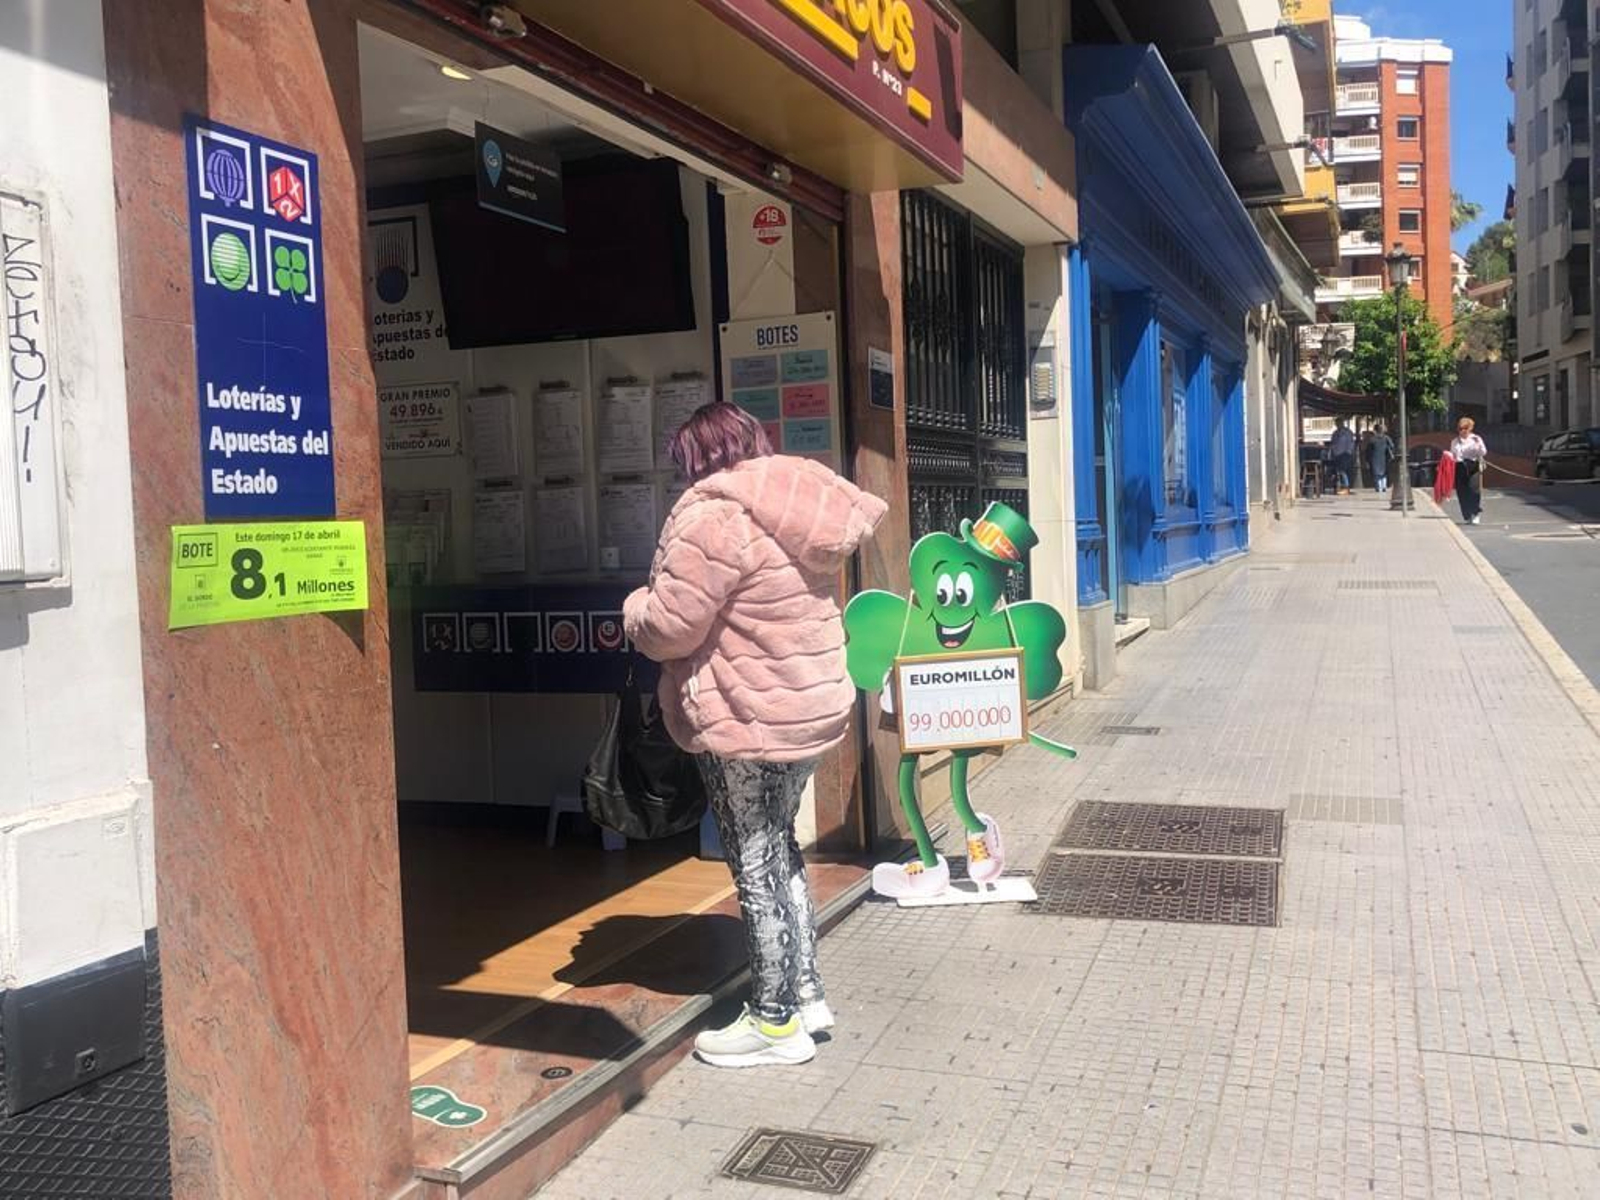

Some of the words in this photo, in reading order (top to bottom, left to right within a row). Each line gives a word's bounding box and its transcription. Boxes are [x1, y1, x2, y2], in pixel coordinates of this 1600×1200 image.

[425, 309, 434, 324] y
[372, 327, 431, 347] puestas
[756, 324, 799, 346] BOTES
[206, 382, 286, 413] Loterías
[290, 395, 301, 421] y
[380, 389, 409, 403] GRAN
[412, 388, 451, 400] PREMIO
[209, 425, 297, 458] Apuestas
[302, 429, 329, 455] del
[385, 440, 425, 451] VENDIDO
[211, 467, 278, 495] Estado
[235, 532, 254, 543] Este
[255, 531, 291, 543] domingo
[293, 531, 303, 541] 17
[304, 531, 316, 540] de
[317, 529, 341, 540] abril
[181, 542, 213, 560] BOTE
[297, 578, 356, 596] Millones
[910, 666, 1015, 685] EUROMILLÓN
